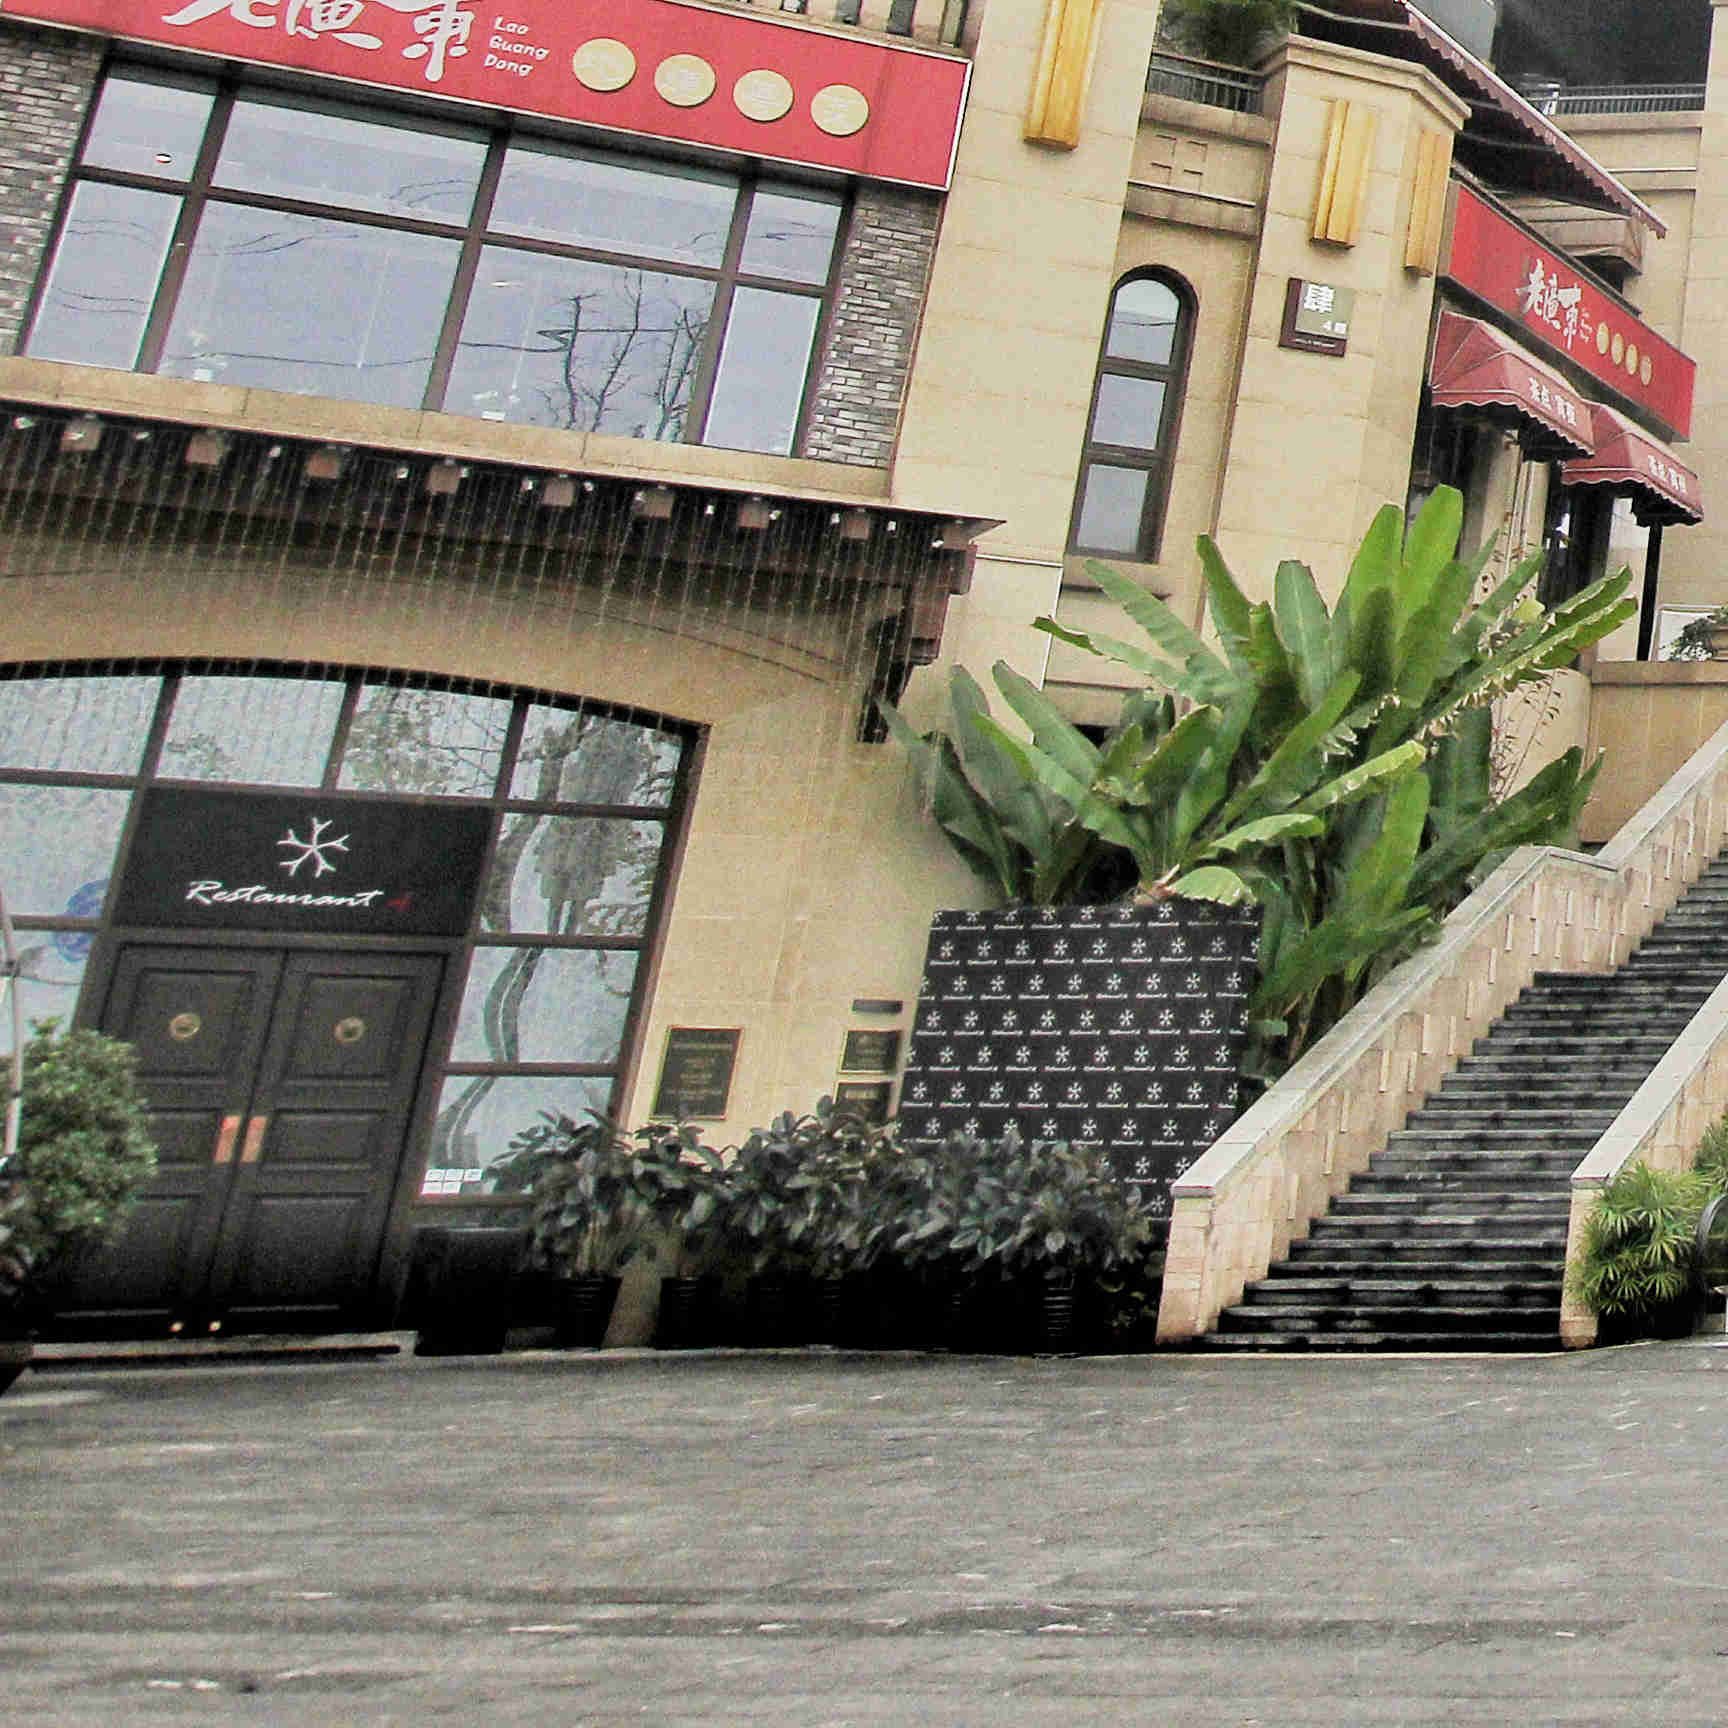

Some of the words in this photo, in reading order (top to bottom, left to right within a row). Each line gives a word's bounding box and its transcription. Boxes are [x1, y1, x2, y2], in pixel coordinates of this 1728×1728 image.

[493, 16, 530, 35] Lao
[488, 35, 551, 61] Guang
[483, 53, 534, 78] Dong
[185, 879, 385, 908] Restaurant
